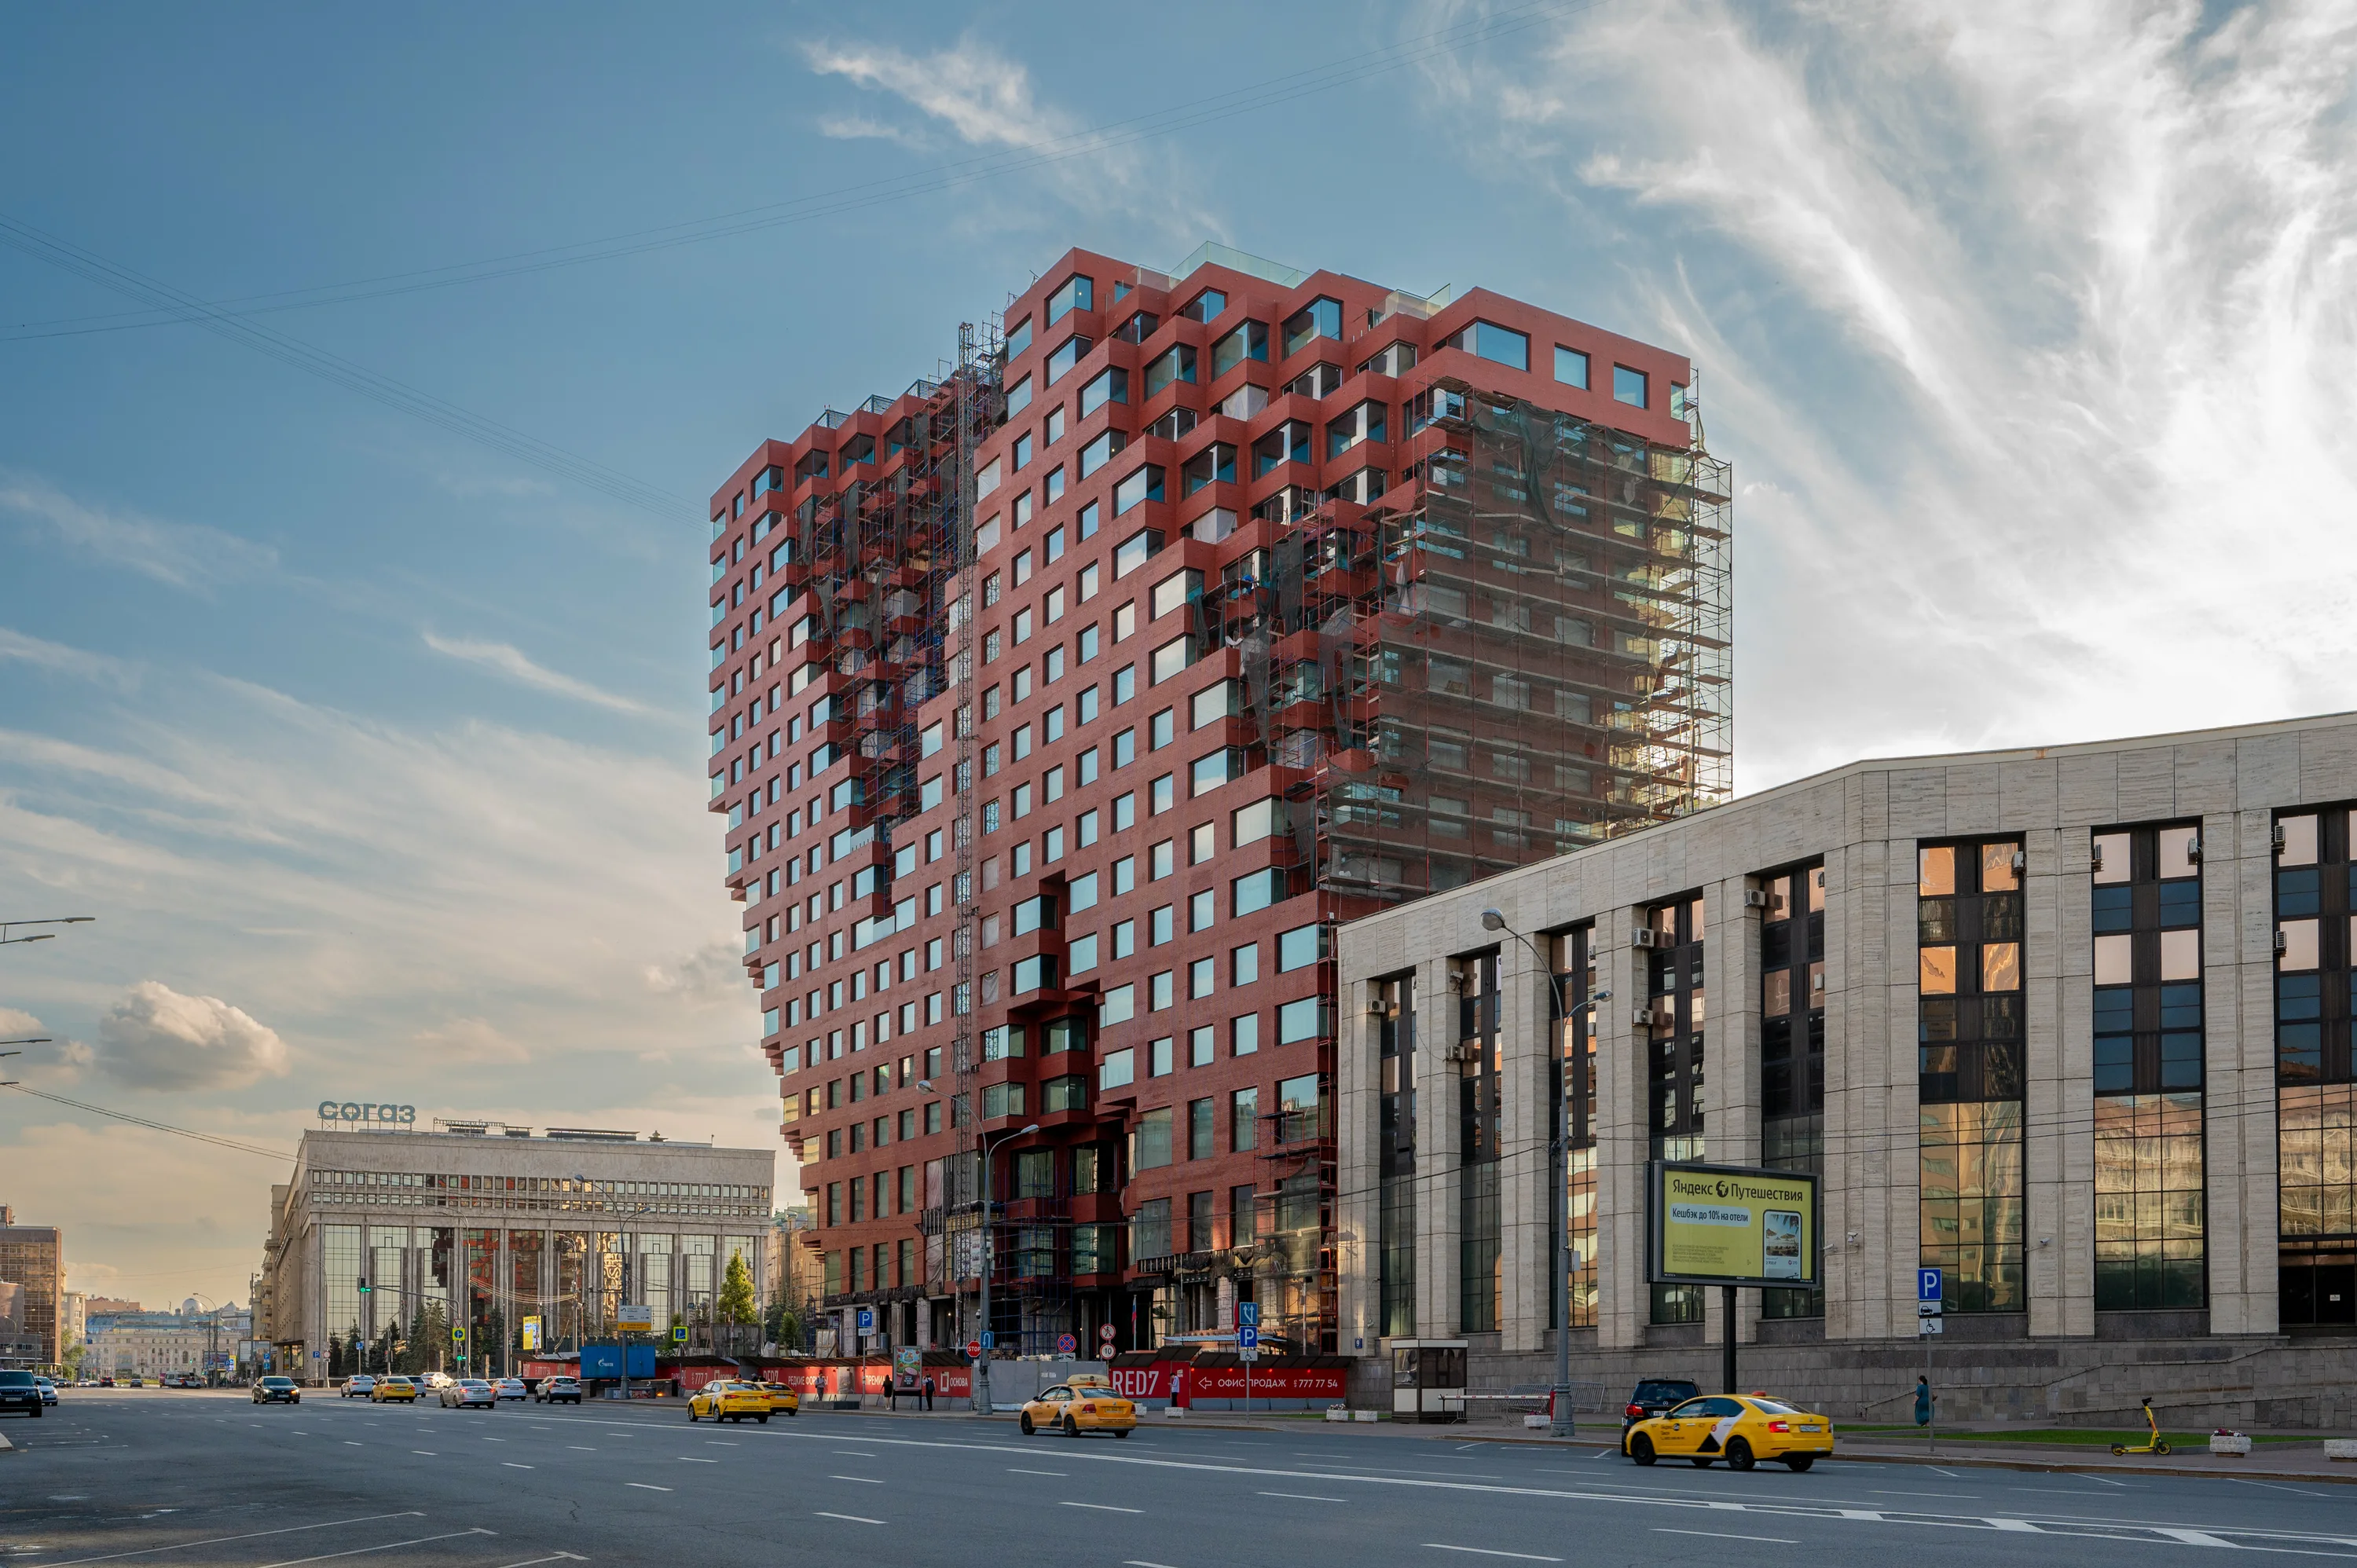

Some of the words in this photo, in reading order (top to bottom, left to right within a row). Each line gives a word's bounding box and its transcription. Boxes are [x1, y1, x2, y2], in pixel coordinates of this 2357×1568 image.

[1673, 1179, 1713, 1196] Яндекс
[1731, 1183, 1803, 1201] Путешествия
[1672, 1208, 1698, 1218] Кешбэк
[1699, 1211, 1707, 1220] до
[1708, 1210, 1720, 1220] 10%
[1729, 1213, 1748, 1222] отели
[1924, 1272, 1937, 1297] P
[862, 1313, 870, 1325] P
[1244, 1328, 1254, 1346] P
[788, 1376, 805, 1387] РЕДКИЕ
[949, 1377, 968, 1387] ОСНОВА
[1113, 1370, 1159, 1395] RED7
[1218, 1379, 1245, 1387] ОФИС
[1248, 1379, 1287, 1389] ПРОДАЖ
[1299, 1379, 1313, 1388] 777
[1315, 1379, 1325, 1388] 77
[1327, 1379, 1338, 1388] 54
